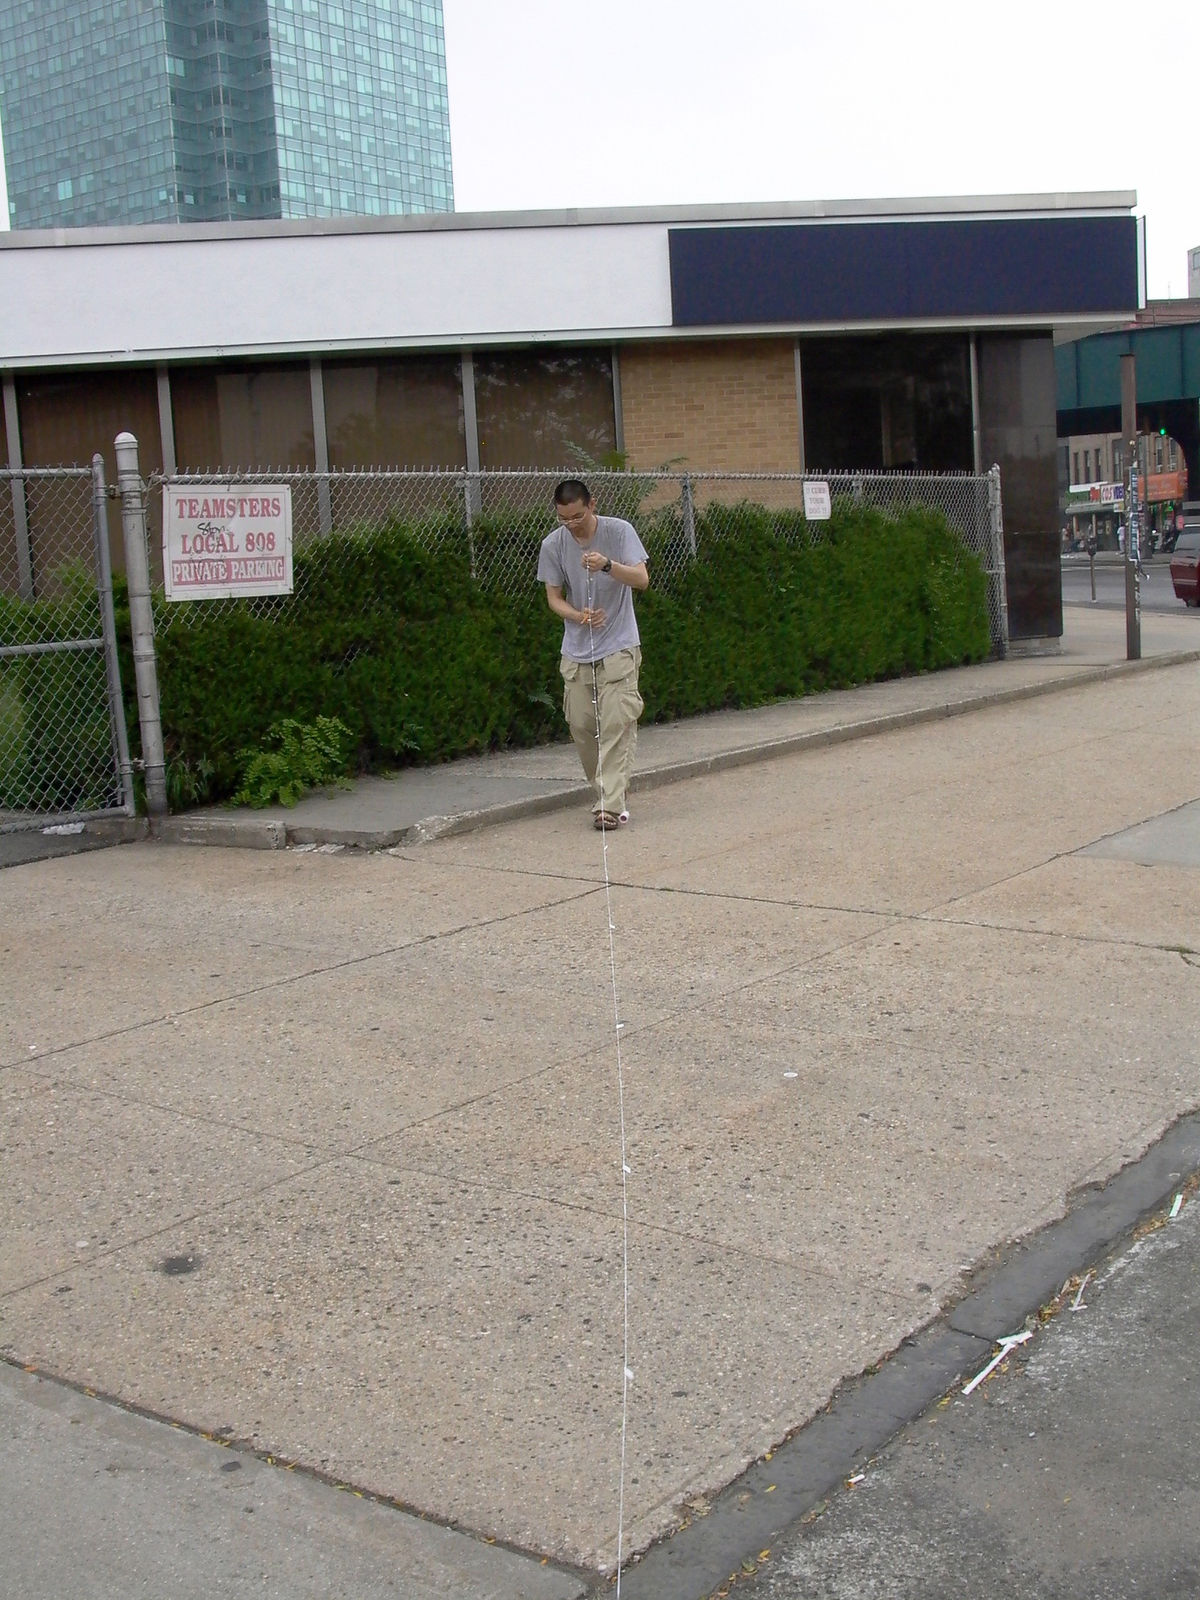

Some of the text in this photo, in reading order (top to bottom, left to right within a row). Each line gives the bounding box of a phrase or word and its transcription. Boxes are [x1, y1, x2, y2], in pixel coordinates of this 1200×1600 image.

[176, 498, 281, 519] TEAMSTERS
[181, 532, 275, 554] LOCAL 808
[173, 559, 284, 582] PRIVATE PARKING
